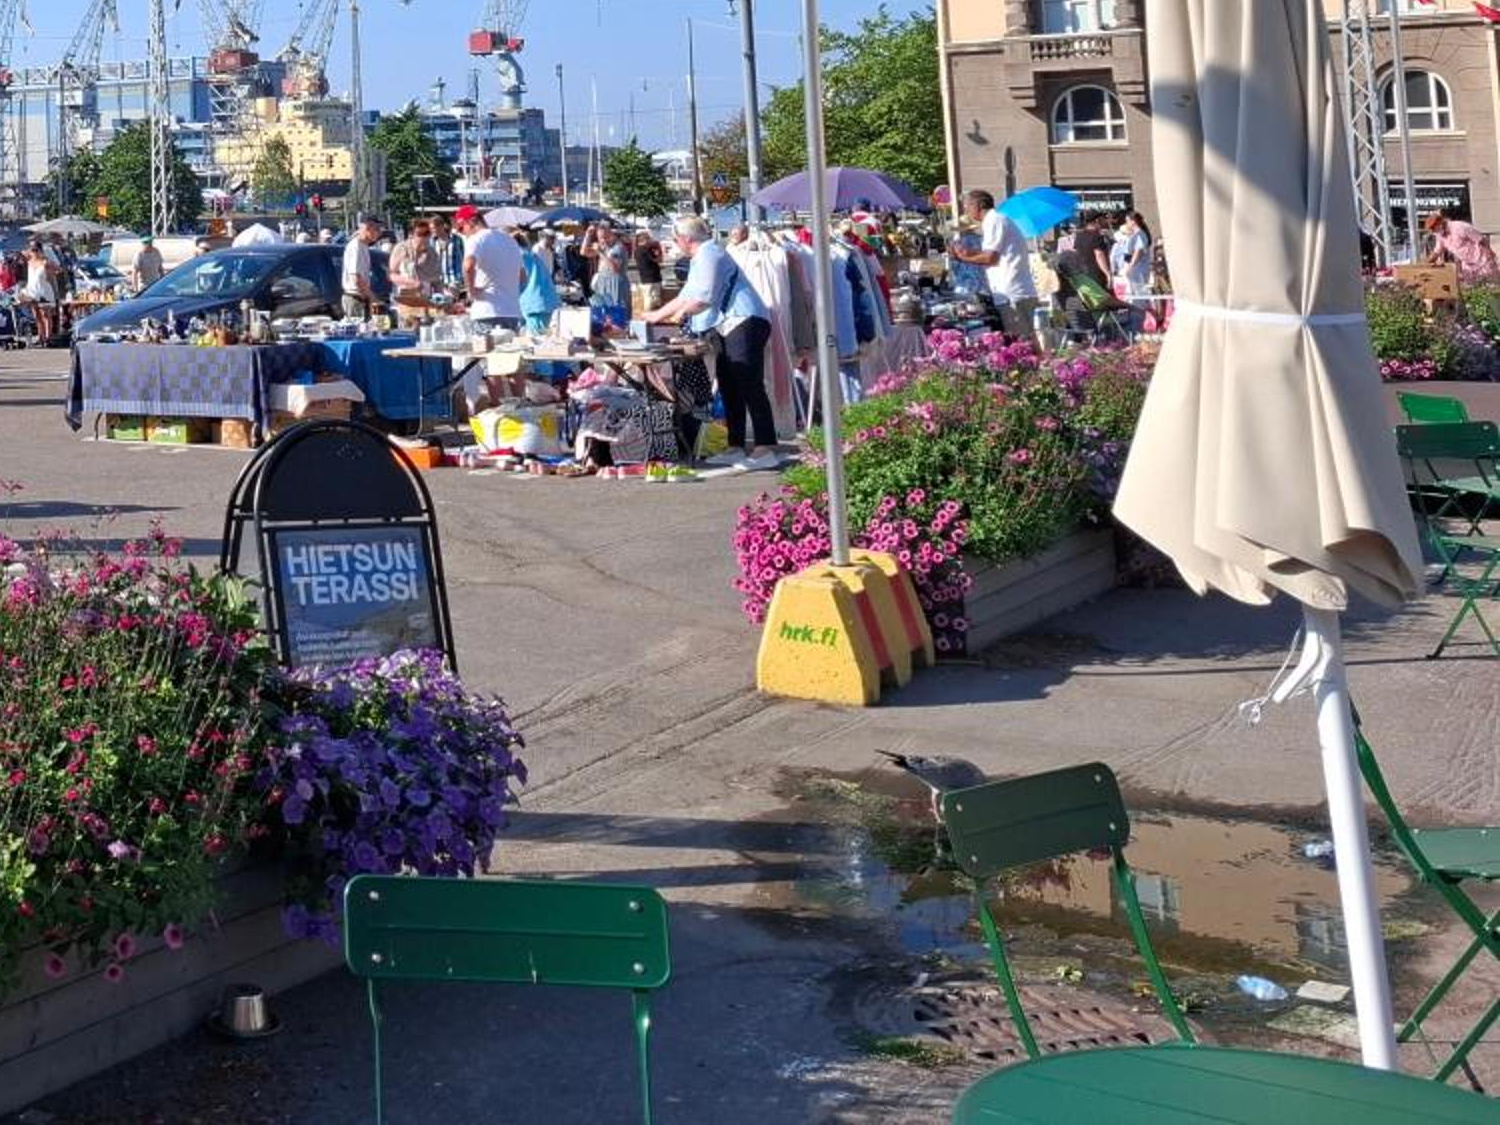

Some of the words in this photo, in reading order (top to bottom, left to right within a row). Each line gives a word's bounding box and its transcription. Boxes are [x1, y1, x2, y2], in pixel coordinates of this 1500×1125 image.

[1389, 197, 1460, 207] HENGWAY'S
[286, 543, 417, 574] HIETSUN
[291, 572, 419, 605] TERASSI
[779, 620, 838, 645] hrk.fi
